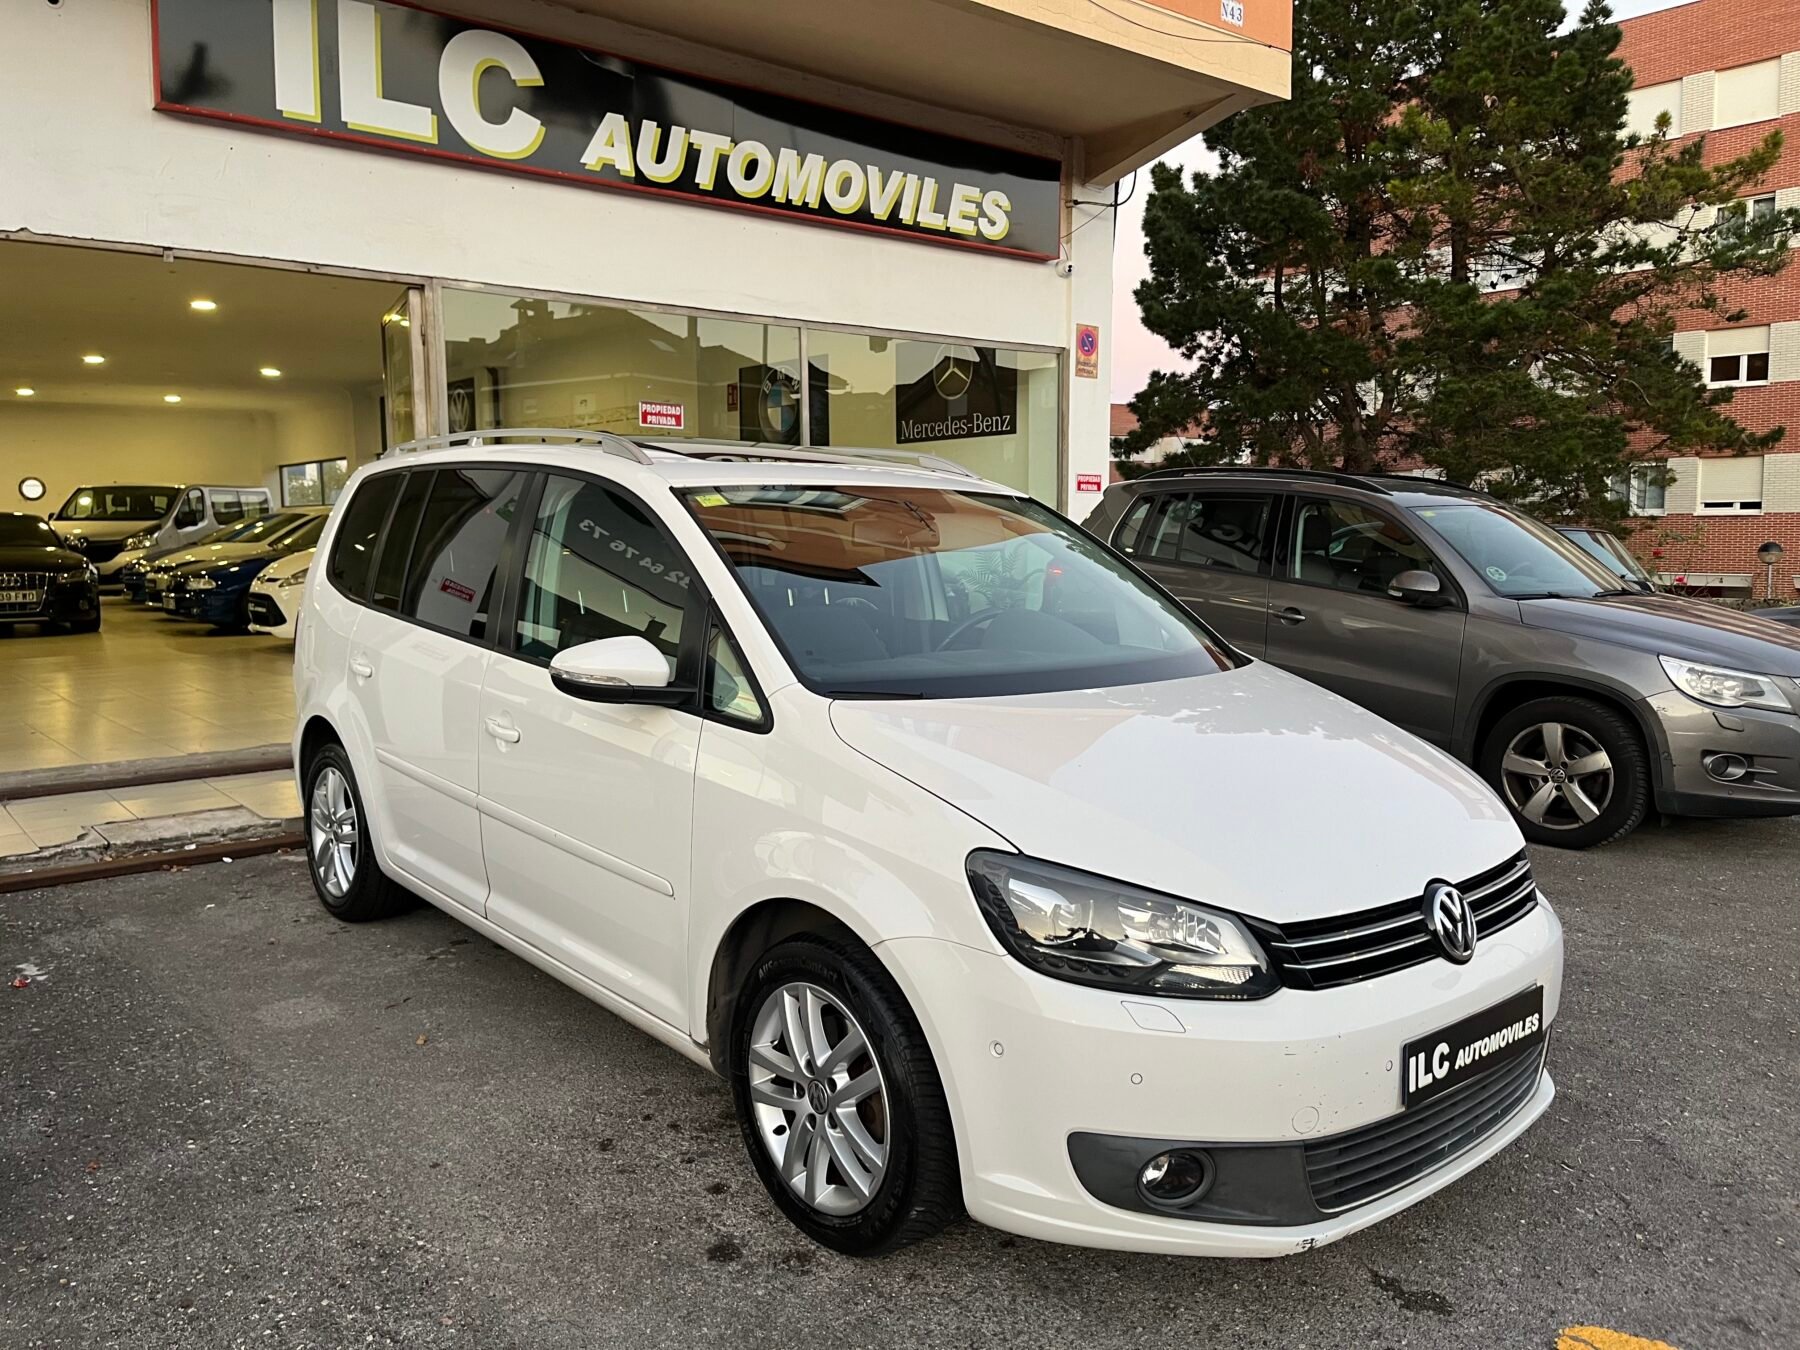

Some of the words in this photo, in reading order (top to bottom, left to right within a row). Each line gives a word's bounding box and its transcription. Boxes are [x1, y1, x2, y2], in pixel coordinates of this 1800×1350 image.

[272, 0, 546, 159] ILC
[580, 112, 1011, 240] AUTOMOVILES
[642, 404, 681, 415] PROPIEDAD
[647, 415, 676, 425] PRIVADA
[901, 413, 1011, 440] Mercedes-Benz
[1409, 1042, 1450, 1093] ILC
[1454, 1012, 1540, 1070] AUTOMOVILES
